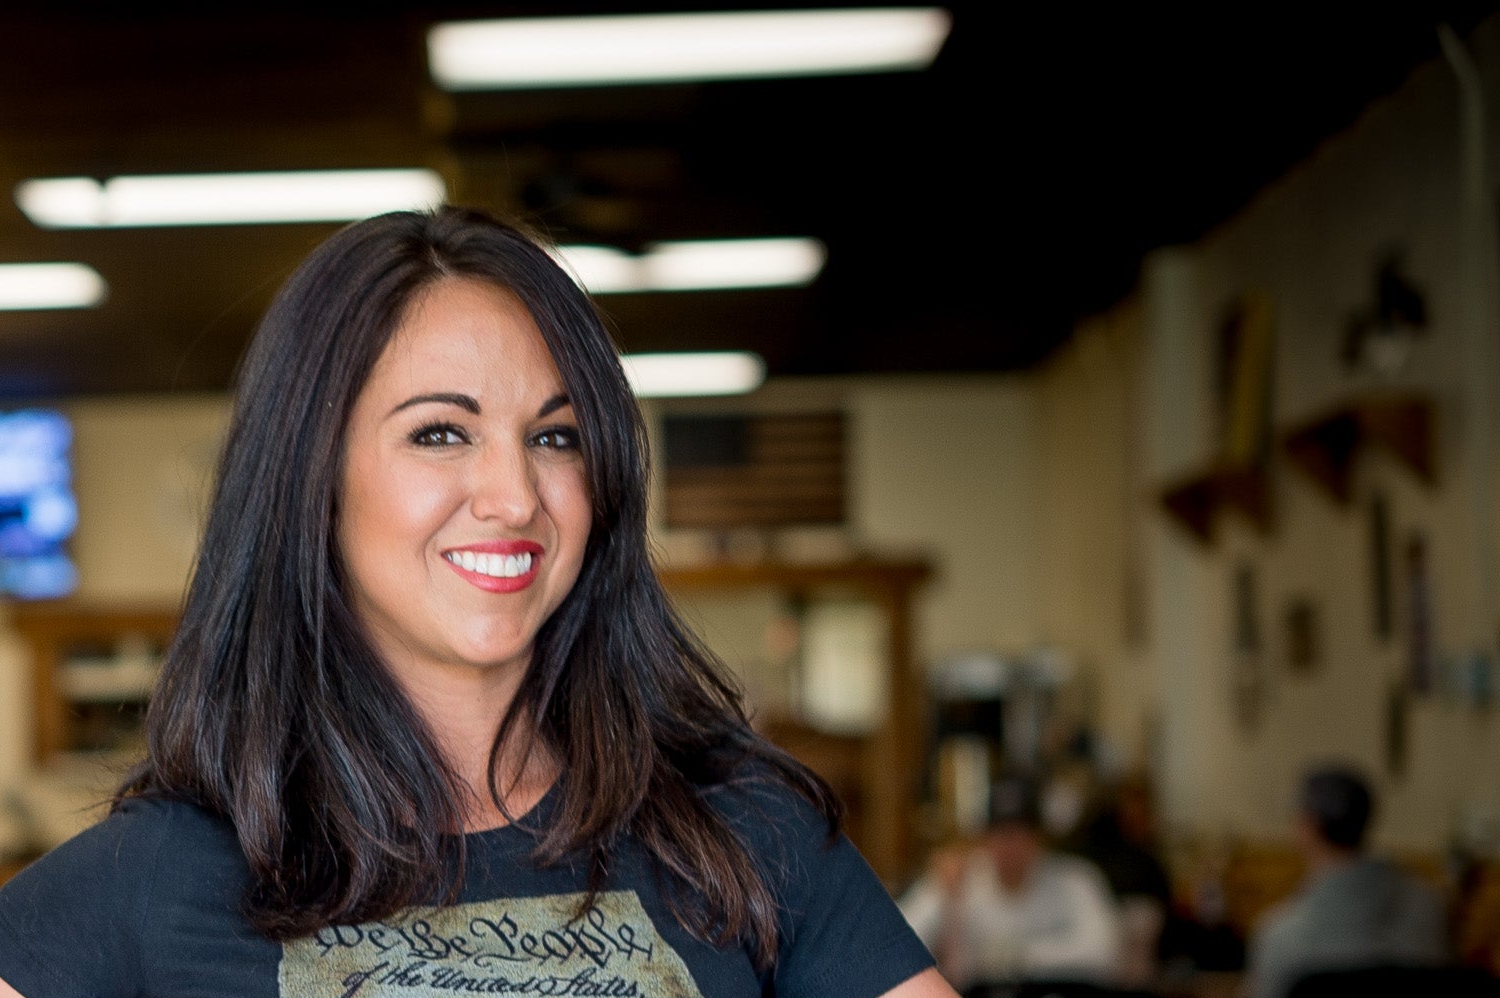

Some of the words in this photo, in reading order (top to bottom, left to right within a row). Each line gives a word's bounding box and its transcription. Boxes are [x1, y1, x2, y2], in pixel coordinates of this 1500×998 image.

[469, 905, 654, 972] People
[377, 961, 428, 986] the
[430, 967, 540, 993] United
